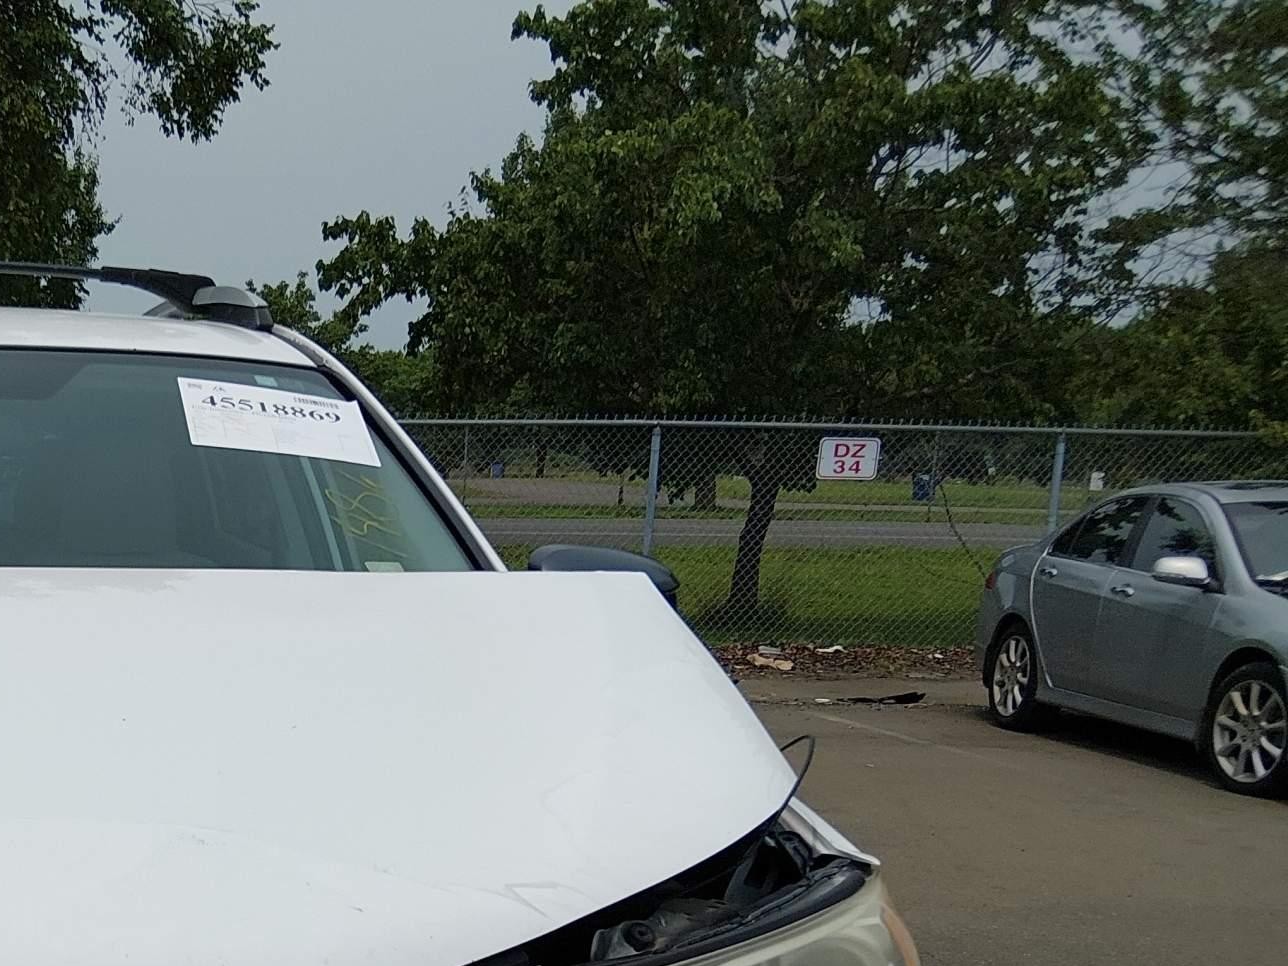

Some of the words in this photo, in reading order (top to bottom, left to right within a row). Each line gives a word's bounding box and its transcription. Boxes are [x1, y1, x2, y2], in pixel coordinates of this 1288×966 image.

[201, 394, 342, 424] 45518869
[833, 443, 867, 458] DZ
[833, 459, 862, 474] 34
